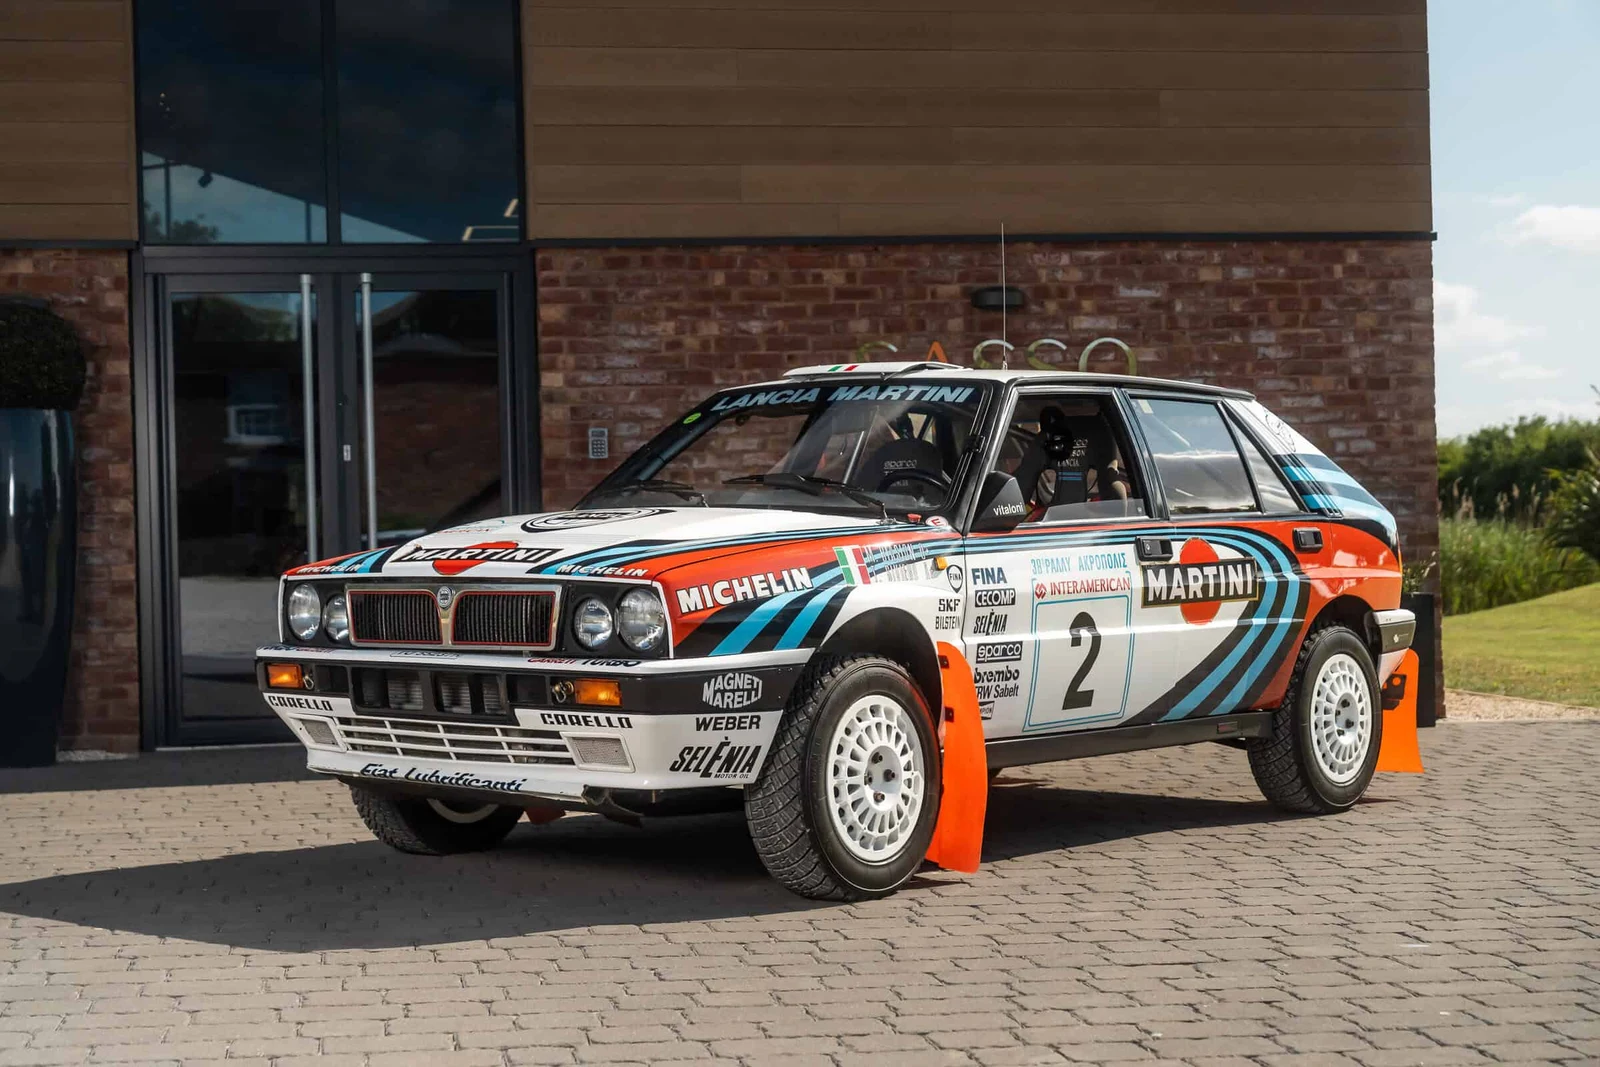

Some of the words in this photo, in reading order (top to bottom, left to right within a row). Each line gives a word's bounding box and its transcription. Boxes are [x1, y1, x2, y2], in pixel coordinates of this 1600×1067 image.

[710, 388, 821, 411] LANCIA
[827, 385, 975, 402] MARTINI
[993, 502, 1024, 516] vitaloni
[401, 549, 551, 561] MARTINI
[296, 563, 365, 574] MICHELIN
[557, 564, 648, 577] MICHELIN
[971, 567, 1008, 585] FINA
[676, 566, 813, 614] MICHELIN
[1050, 577, 1131, 596] INTERAMERICAN
[1146, 563, 1253, 602] MARTINI
[938, 598, 960, 612] SKF
[976, 590, 1015, 605] CECOMP
[935, 616, 962, 630] BILSTEIN
[977, 643, 1021, 662] sparco
[1062, 611, 1102, 710] 2
[974, 665, 1020, 684] brembo
[702, 672, 763, 704] MAGNETI
[702, 680, 763, 709] MARELLI
[993, 683, 1019, 699] Sabelt
[268, 695, 333, 711] CARELLO
[540, 713, 633, 729] CARELLO
[695, 715, 761, 731] WEBER
[360, 763, 399, 779] Fiat
[404, 767, 527, 791] Lubrificanti
